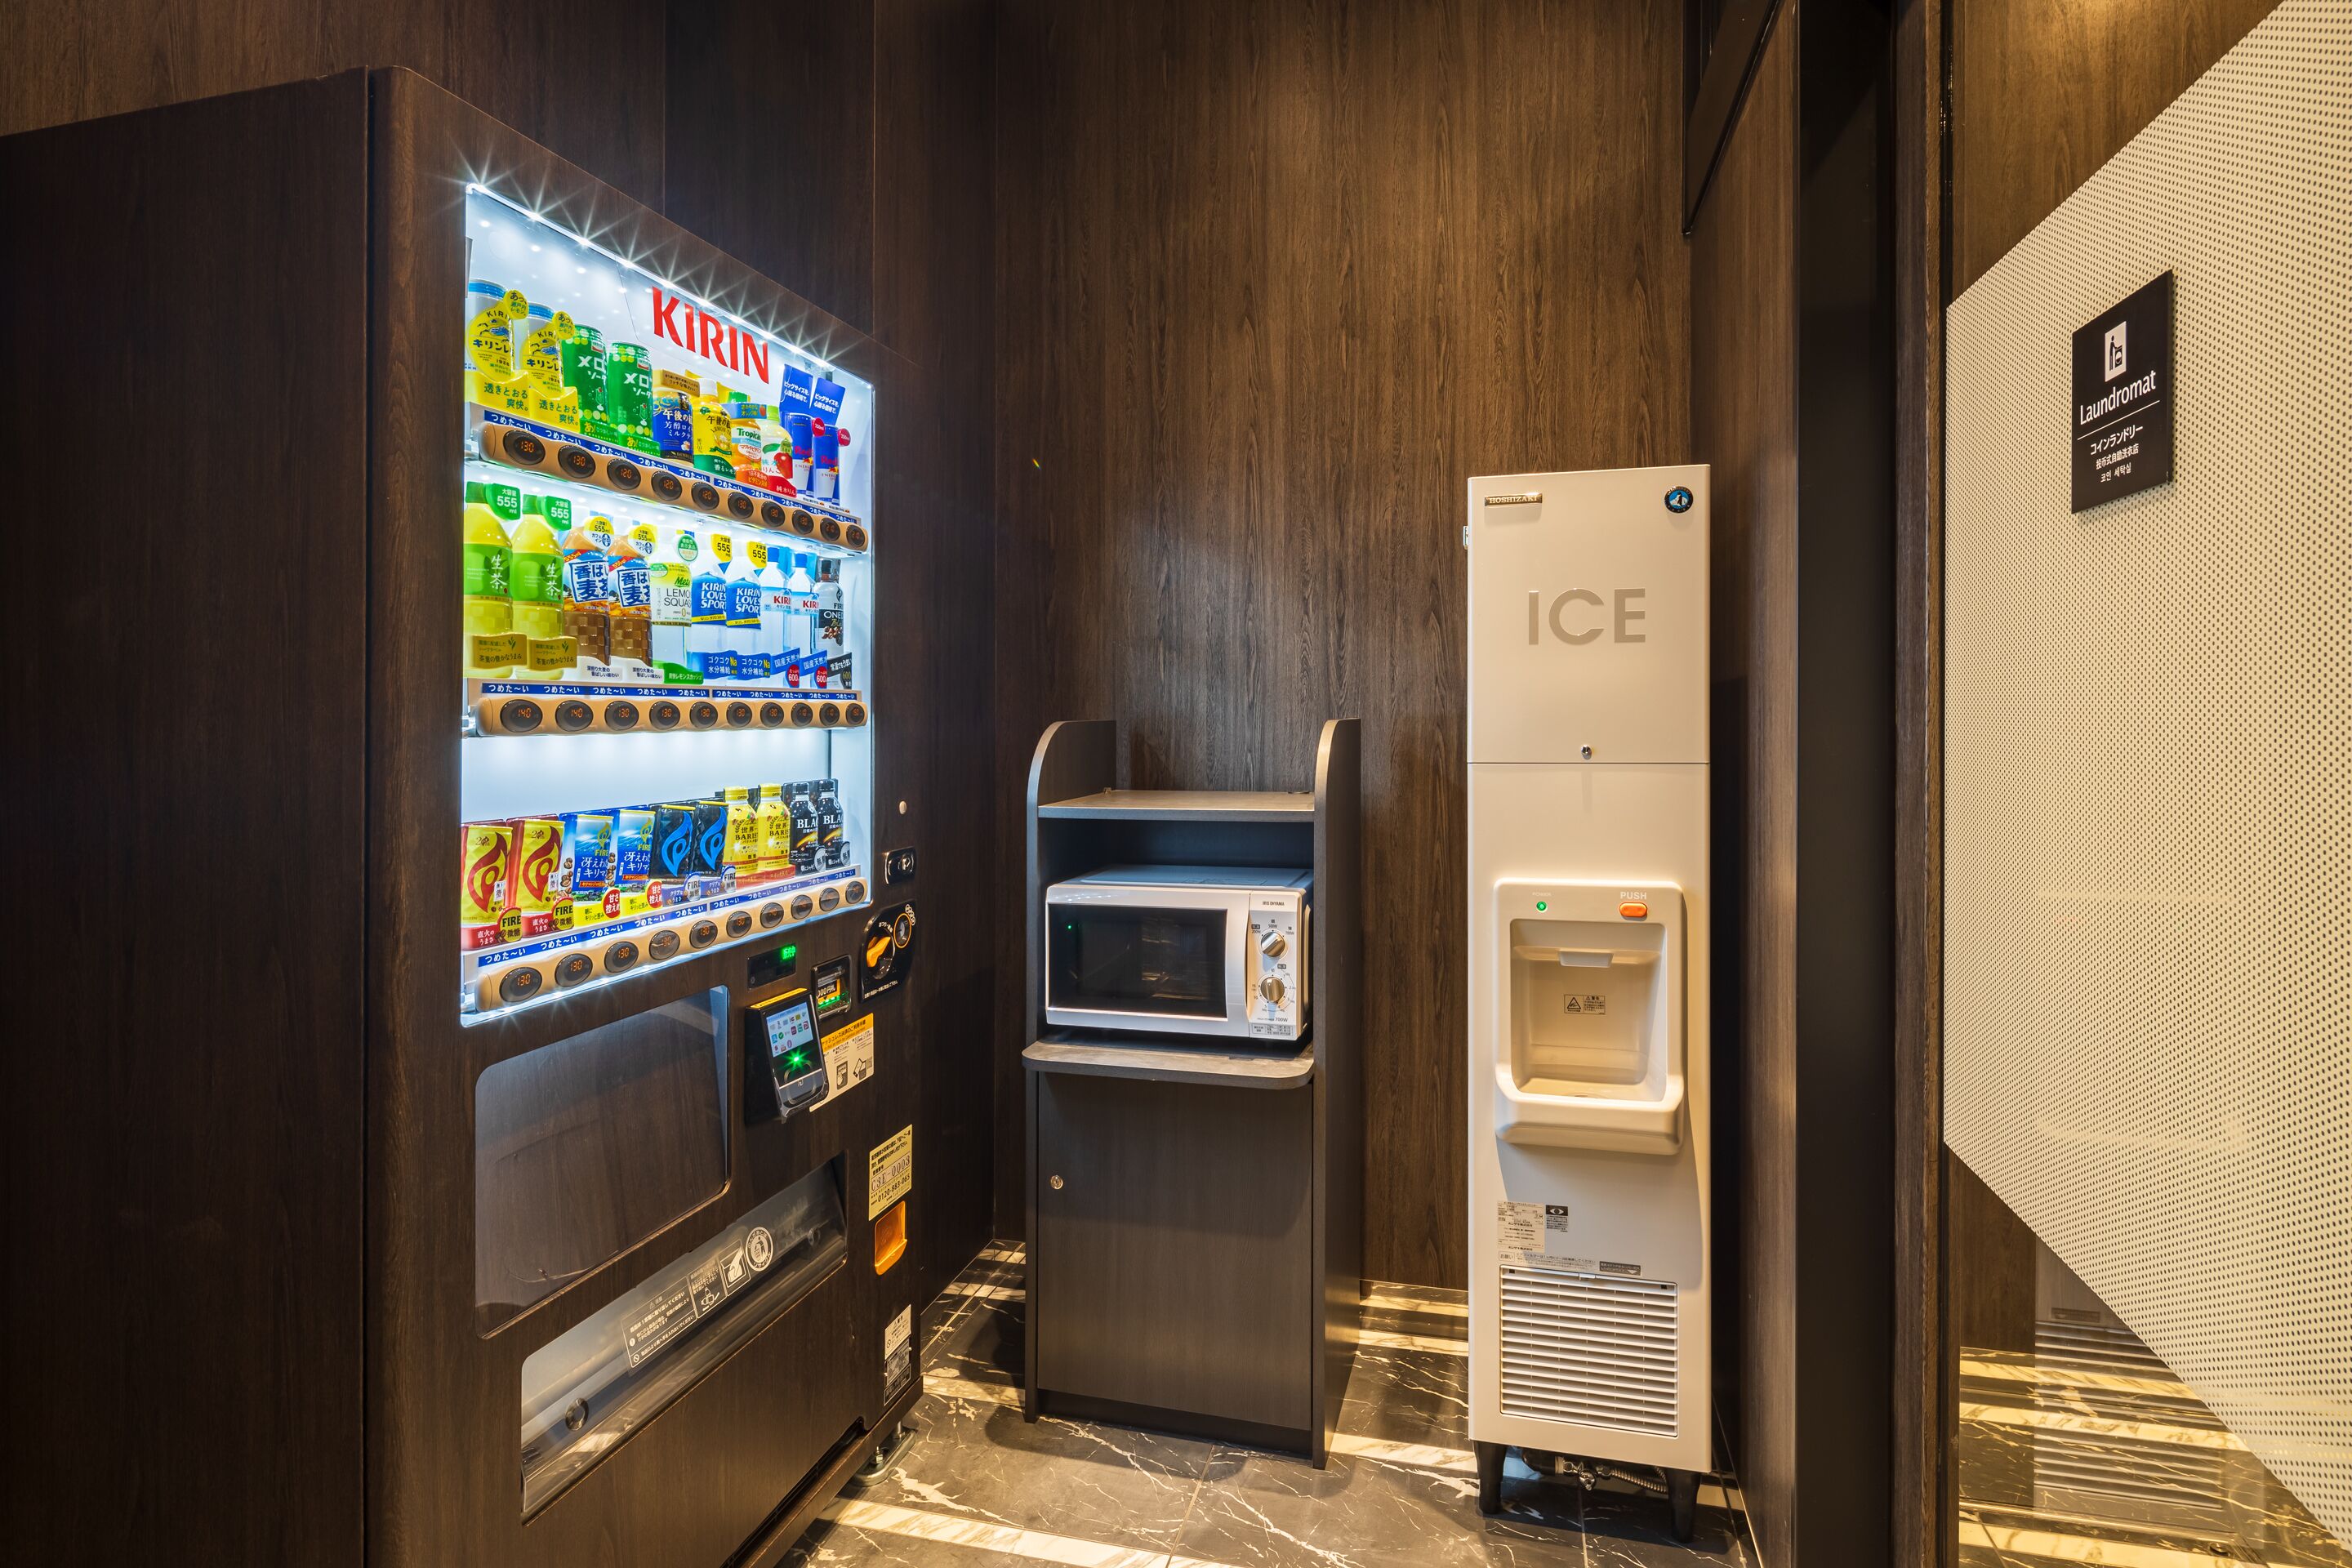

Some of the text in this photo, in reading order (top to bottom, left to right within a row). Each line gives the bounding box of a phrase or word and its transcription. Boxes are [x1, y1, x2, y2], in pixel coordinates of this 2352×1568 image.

[653, 286, 769, 385] KIRIN
[484, 382, 528, 399] 透きとおる
[2080, 369, 2156, 425] Laundromat
[506, 399, 528, 412] 爽快。
[539, 399, 577, 414] 透きとおる
[559, 414, 579, 425] 爽快。
[2091, 425, 2144, 456] コインランドリー
[521, 441, 535, 453] 130
[572, 454, 586, 466] 130
[2096, 443, 2140, 471] 投币式自助洗衣店
[2100, 461, 2132, 483] 코인 세탁실
[497, 496, 518, 508] 555
[1490, 496, 1537, 504] HOSHIZAKI
[550, 507, 569, 519] 555
[638, 533, 648, 541] 555
[717, 542, 731, 553] 555
[753, 549, 767, 560] 555
[490, 555, 508, 590] 生茶
[546, 563, 561, 596] 生茶
[702, 582, 725, 593] KIRIN
[737, 587, 761, 598] KIRIN
[701, 591, 726, 601] LOVES
[736, 595, 761, 605] LOVES
[1528, 587, 1646, 645] ICE
[479, 653, 522, 664] 茶葉の豊かなうまみ
[536, 657, 574, 666] 茶葉の豊かなうまみ
[730, 657, 737, 666] Na
[764, 659, 771, 669] Na
[708, 666, 731, 675] 水分補給
[742, 668, 764, 677] 水分補給
[518, 708, 532, 719] 140
[571, 707, 583, 719] 140
[618, 708, 630, 718] 130
[662, 708, 672, 718] 130
[651, 885, 661, 894] 甘さ
[688, 880, 701, 890] FIRE
[608, 893, 619, 902] 甘さ
[1619, 891, 1647, 900] PUSH
[555, 905, 573, 916] FIRE
[502, 915, 522, 928] FIRE
[532, 918, 549, 926] 直火の
[559, 916, 572, 925] 微糖
[585, 912, 604, 921] キリッと苦み
[477, 929, 495, 939] 直火の
[507, 929, 521, 938] 微糖
[535, 925, 548, 933] うまさ
[479, 937, 494, 947] うまさ
[618, 947, 629, 959] 130
[570, 960, 582, 972] 130
[518, 973, 531, 986] 130
